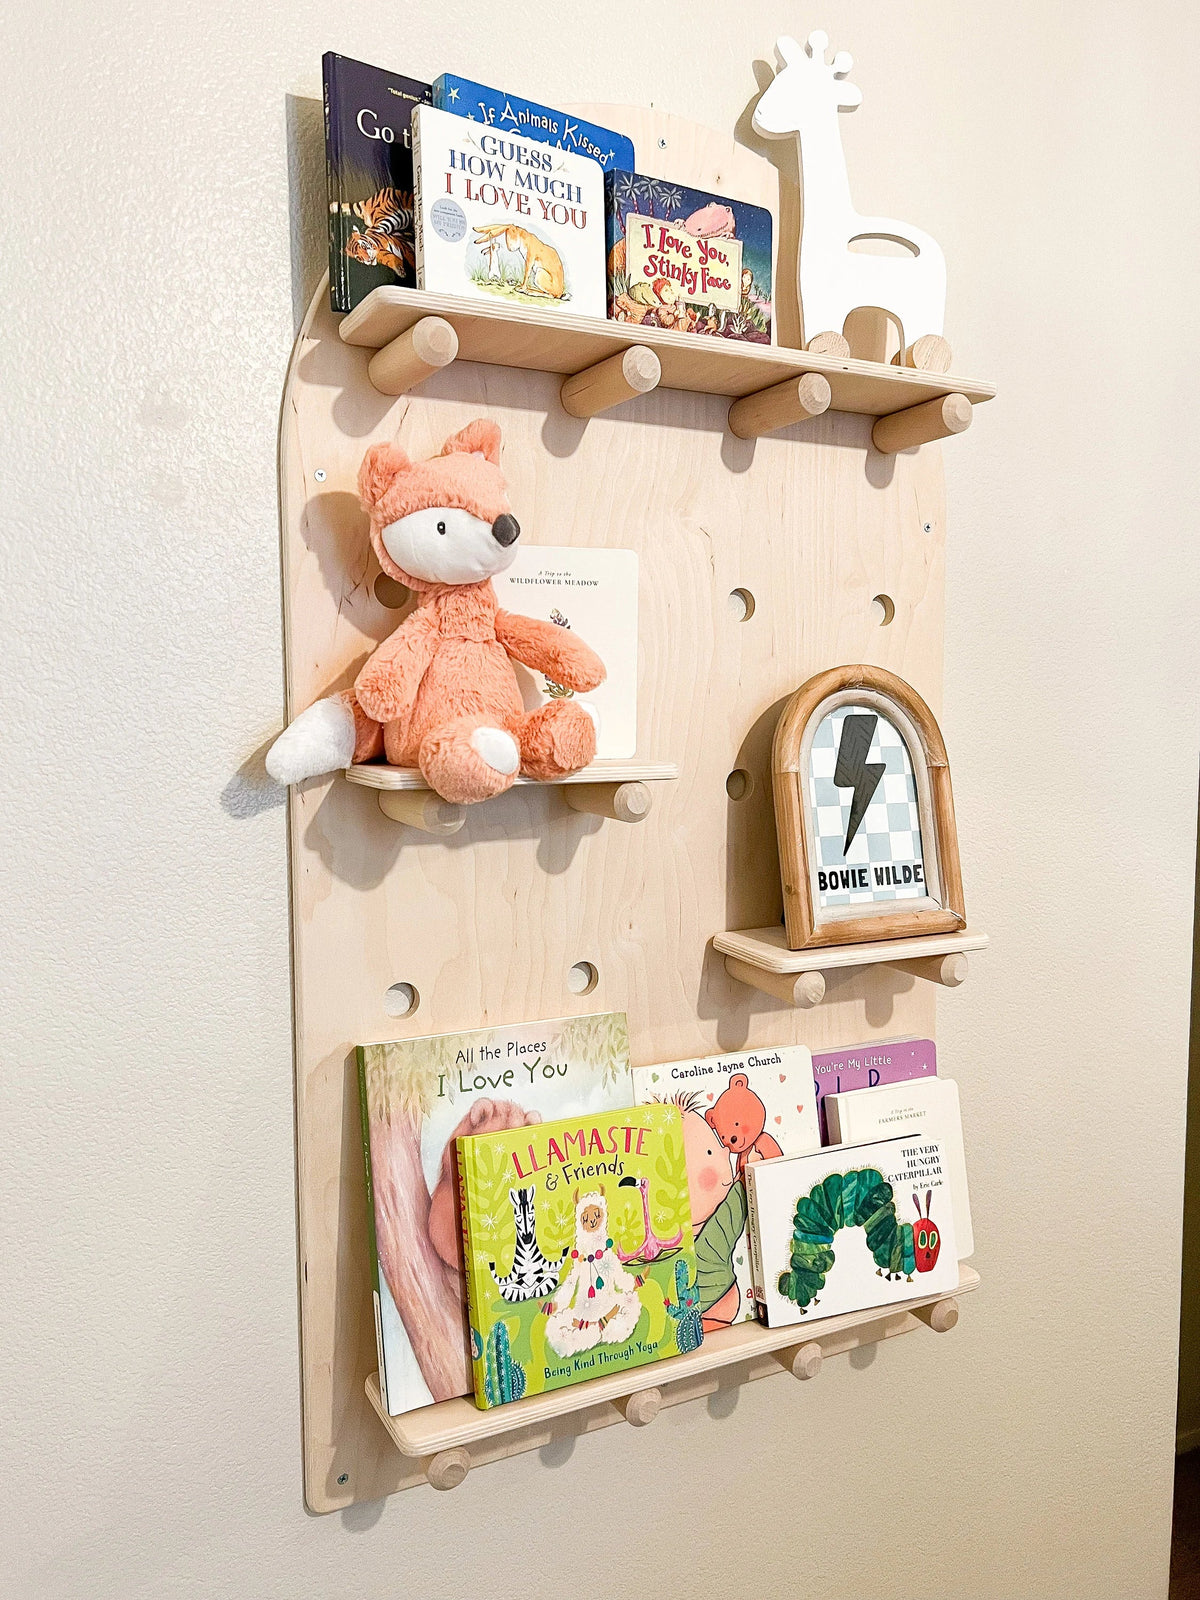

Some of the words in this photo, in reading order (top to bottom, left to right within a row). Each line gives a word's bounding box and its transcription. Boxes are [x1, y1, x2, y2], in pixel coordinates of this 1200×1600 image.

[356, 108, 395, 143] Go
[477, 101, 496, 125] If
[499, 100, 559, 134] Animals
[562, 119, 610, 166] Kissed
[480, 135, 553, 173] GUESS
[448, 149, 507, 182] HOW
[514, 168, 583, 204] MUCH
[444, 172, 454, 195] I
[464, 178, 532, 216] LOVE
[537, 197, 588, 230] YOU
[641, 223, 655, 249] I
[656, 226, 692, 259] Love
[696, 239, 730, 268] You,
[642, 254, 699, 295] Stinky
[701, 267, 732, 294] Face
[509, 577, 562, 585] WILDFLOWER
[564, 579, 599, 587] MEADOW
[817, 867, 869, 892] BOWIE
[873, 863, 924, 886] WILDE
[455, 1047, 474, 1064] All
[479, 1046, 501, 1061] the
[507, 1041, 547, 1058] Places
[671, 1066, 714, 1080] Caroline
[716, 1062, 745, 1074] Jayne
[747, 1053, 782, 1068] Church
[815, 1062, 844, 1075] You're
[847, 1058, 861, 1071] My
[864, 1055, 892, 1067] Little
[437, 1074, 446, 1097] I
[458, 1070, 514, 1093] Love
[522, 1056, 568, 1084] You
[878, 1115, 904, 1124] FARMERS
[904, 1111, 927, 1120] MARKET
[511, 1125, 652, 1179] LLAMASTE
[900, 1147, 919, 1158] THE
[919, 1144, 940, 1154] VERY
[906, 1155, 941, 1168] HUNGRY
[545, 1172, 559, 1191] &
[561, 1153, 625, 1185] Friends
[887, 1166, 942, 1183] CATERPILLAR
[912, 1183, 919, 1191] by
[919, 1181, 930, 1189] Eric
[930, 1179, 943, 1187] Carle
[752, 1235, 760, 1272] Caterpillar
[544, 1365, 572, 1379] Being
[574, 1354, 595, 1371] Kind
[597, 1345, 634, 1365] Through
[635, 1341, 658, 1354] Yoga
